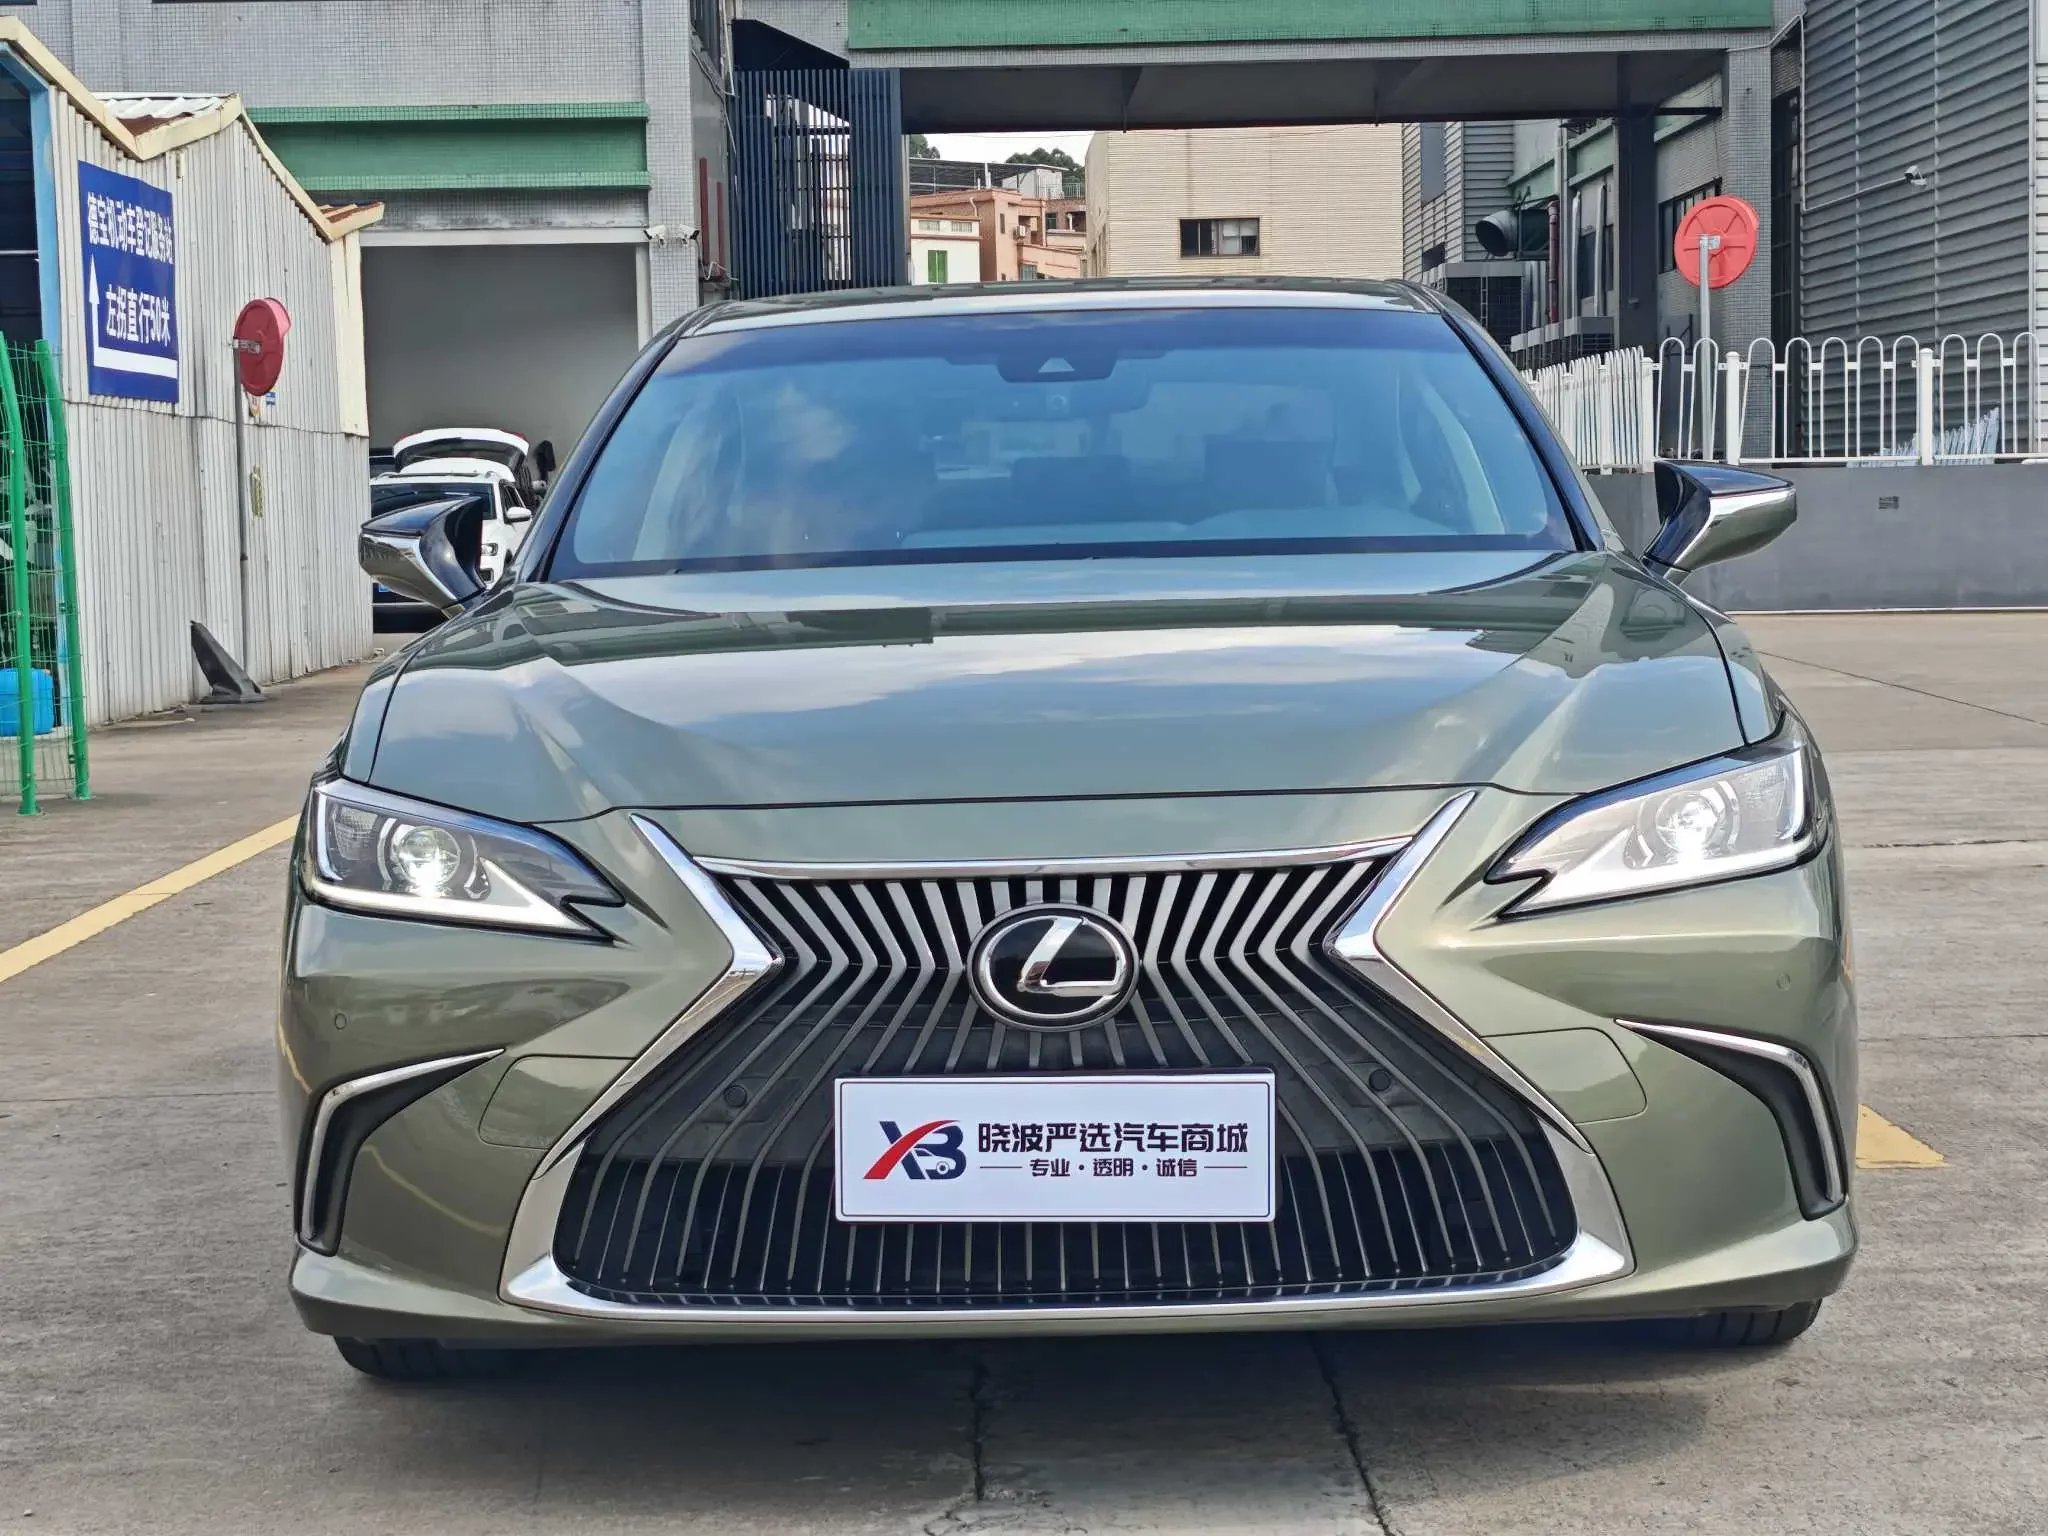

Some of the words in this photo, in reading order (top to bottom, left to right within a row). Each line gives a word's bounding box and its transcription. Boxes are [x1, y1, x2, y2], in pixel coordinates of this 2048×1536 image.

[106, 284, 171, 347] 左拐直行50米
[978, 1122, 1248, 1153] 晓波严选汽车商城
